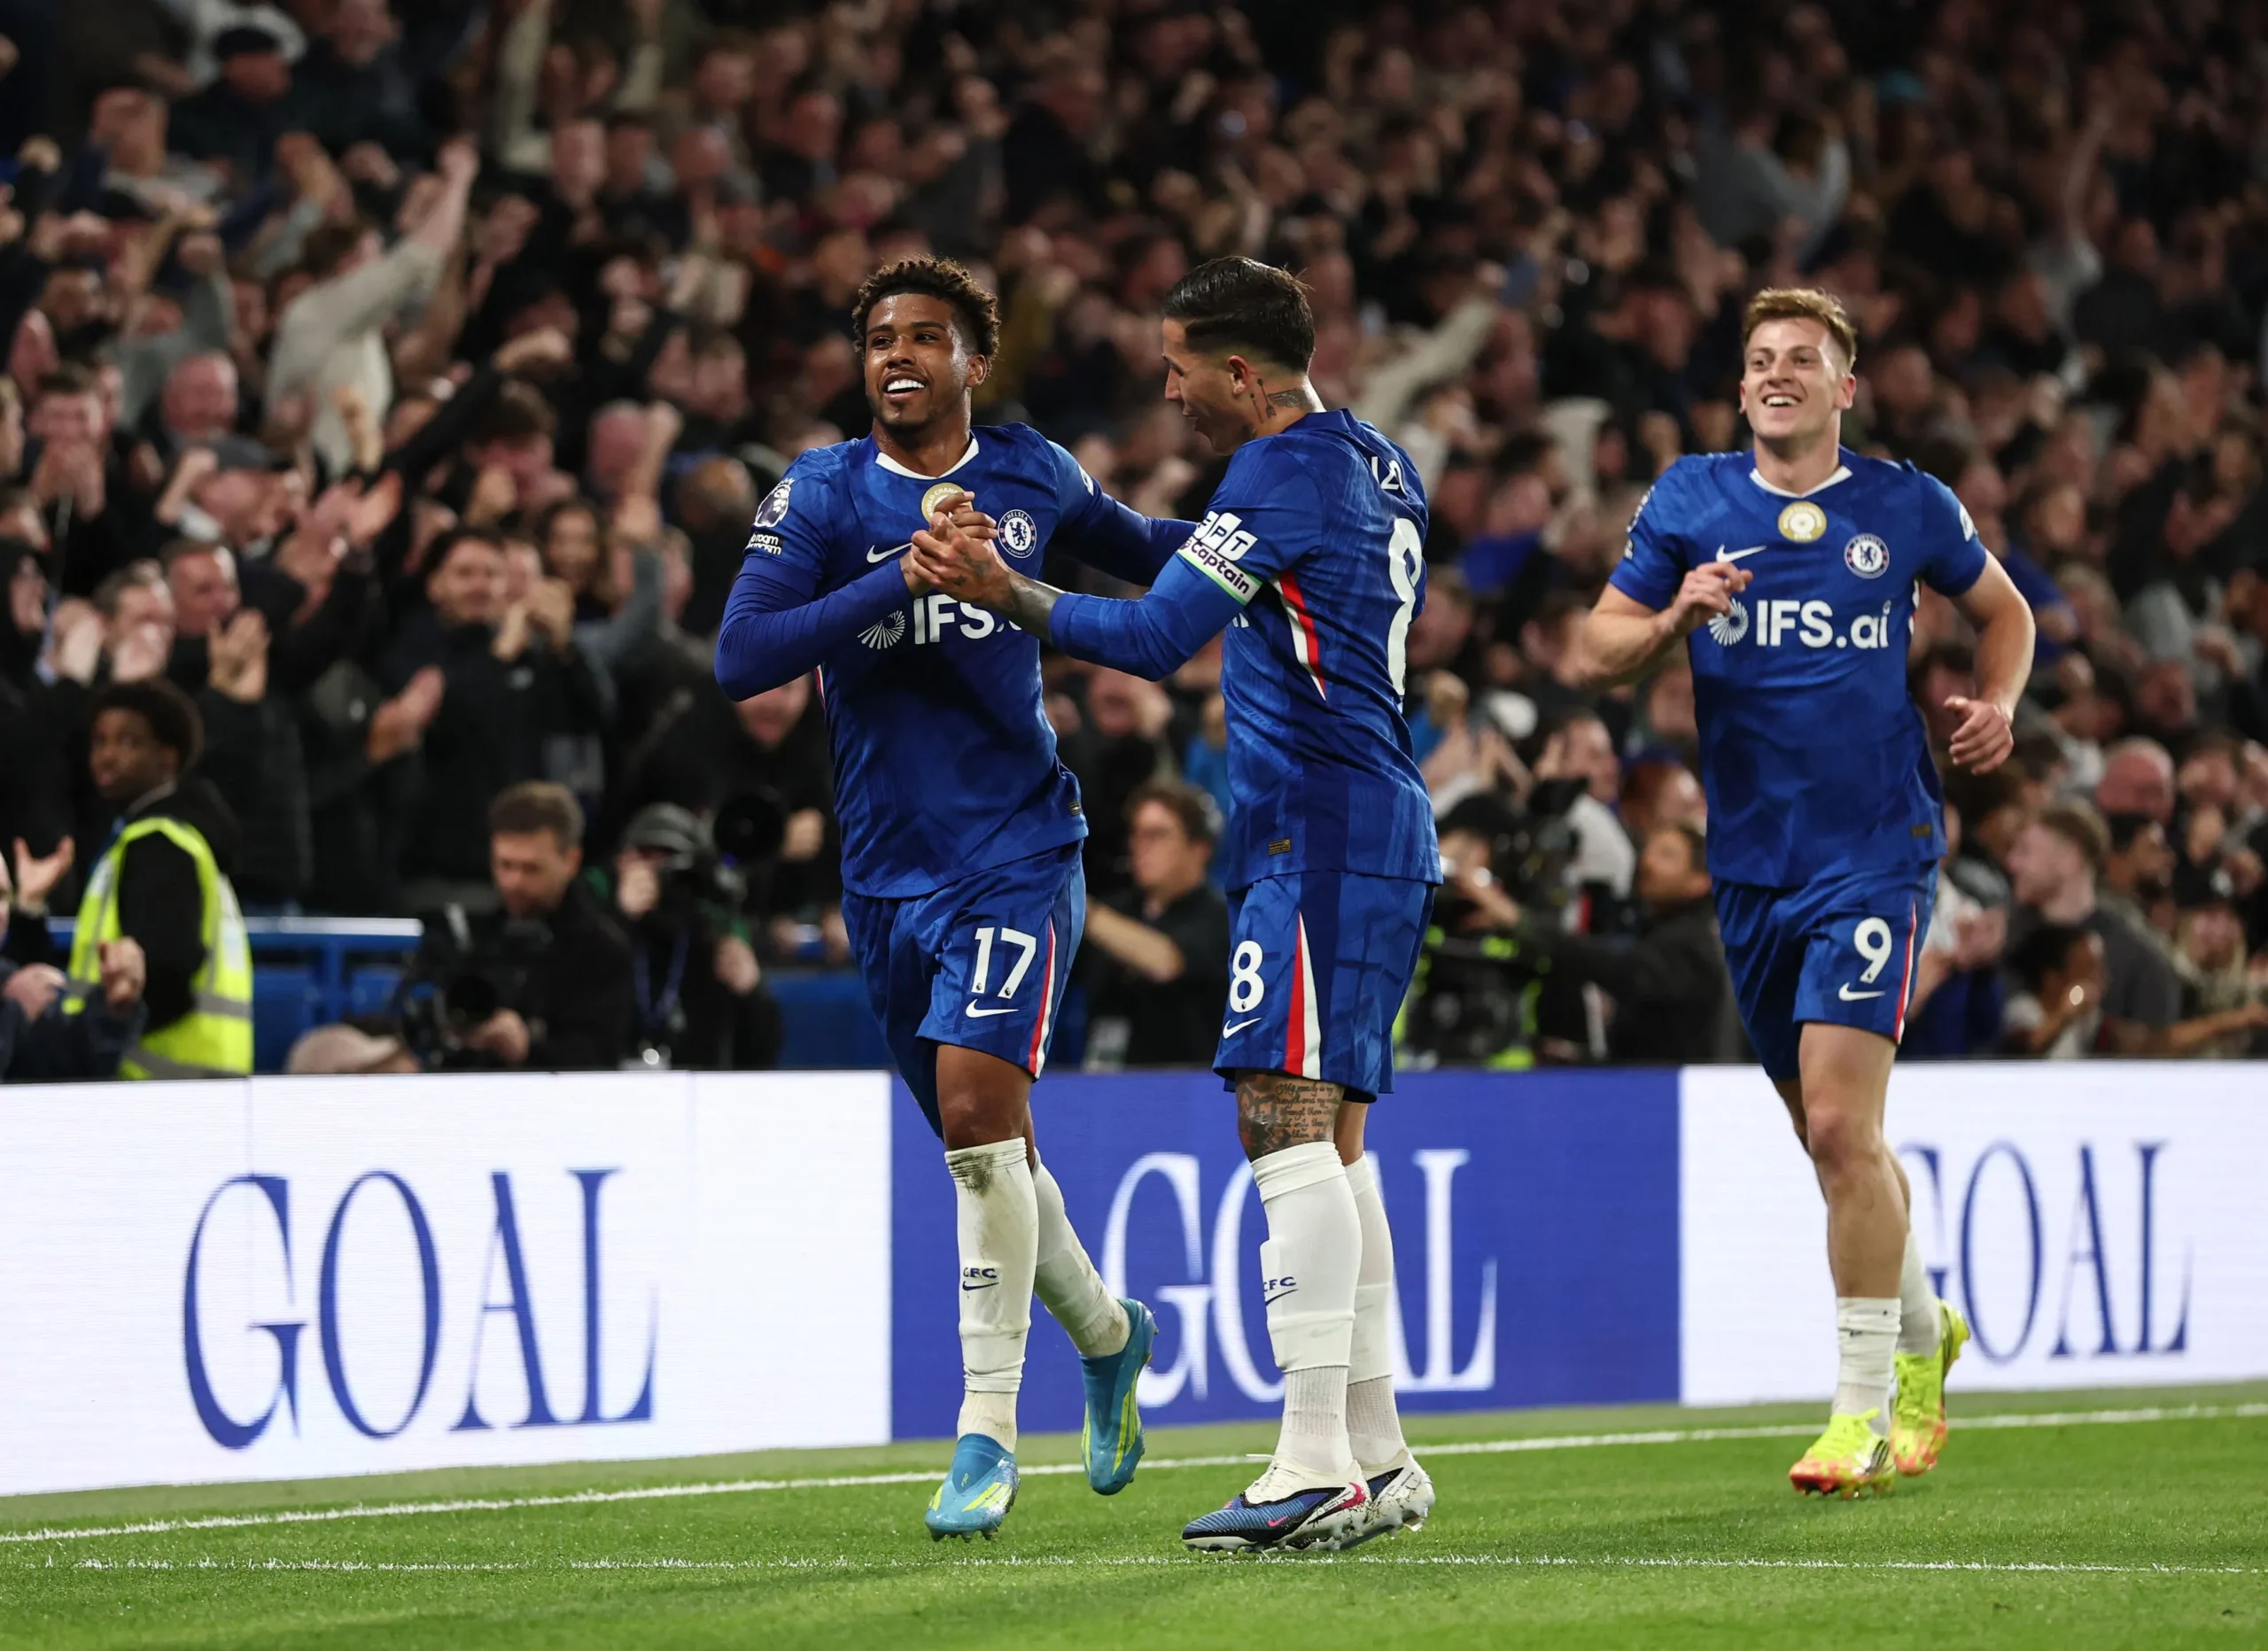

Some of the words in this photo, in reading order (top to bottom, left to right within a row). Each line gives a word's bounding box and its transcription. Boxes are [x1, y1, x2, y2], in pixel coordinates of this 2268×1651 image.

[756, 534, 779, 545] room
[1003, 511, 1029, 523] CHELSEA
[913, 594, 1022, 645] IFS
[1756, 600, 1891, 649] IFS.ai
[972, 927, 1037, 999] 17
[1229, 940, 1264, 1012] 8
[1854, 917, 1892, 984] 9
[183, 1168, 659, 1450] GOAL
